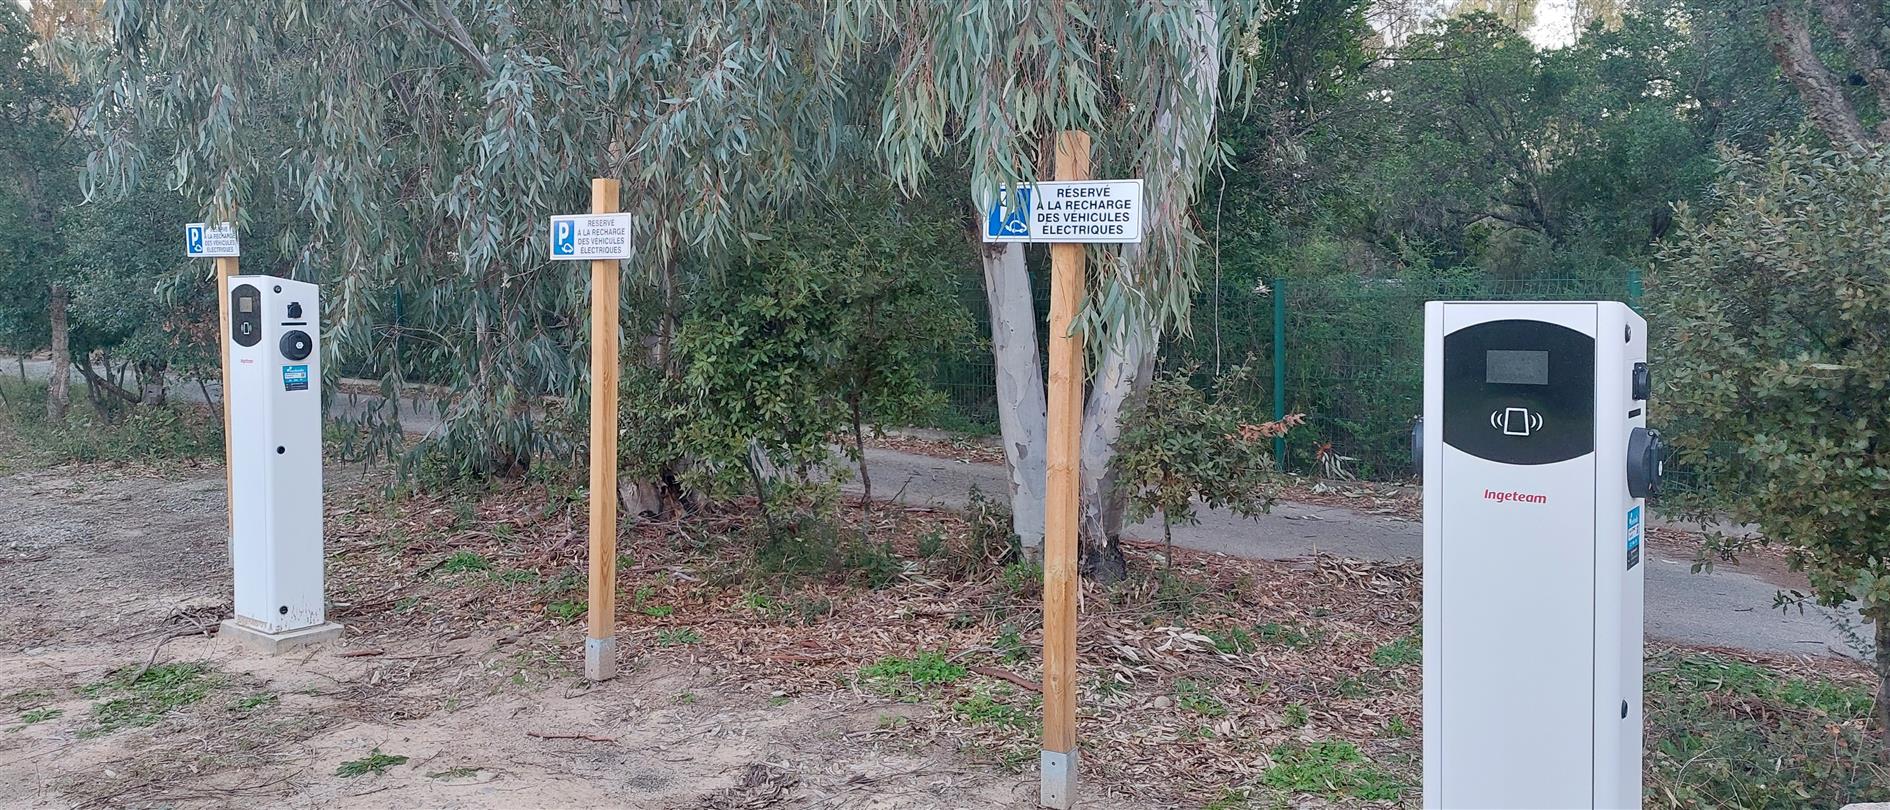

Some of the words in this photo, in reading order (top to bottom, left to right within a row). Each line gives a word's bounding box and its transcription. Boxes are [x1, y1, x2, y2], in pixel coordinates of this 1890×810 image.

[1057, 184, 1111, 198] RÉSERVÉ
[1048, 201, 1061, 210] LA
[1065, 200, 1132, 210] RECHARGE
[1037, 213, 1060, 223] DES
[1063, 210, 1130, 222] VÉHICULES
[558, 222, 569, 245] P
[583, 228, 591, 236] LA
[592, 228, 625, 236] RECHARGE
[1042, 223, 1124, 235] ÉLECTRIQUES
[191, 228, 199, 247] P
[578, 237, 590, 245] DES
[1484, 489, 1547, 504] Ingeteam
